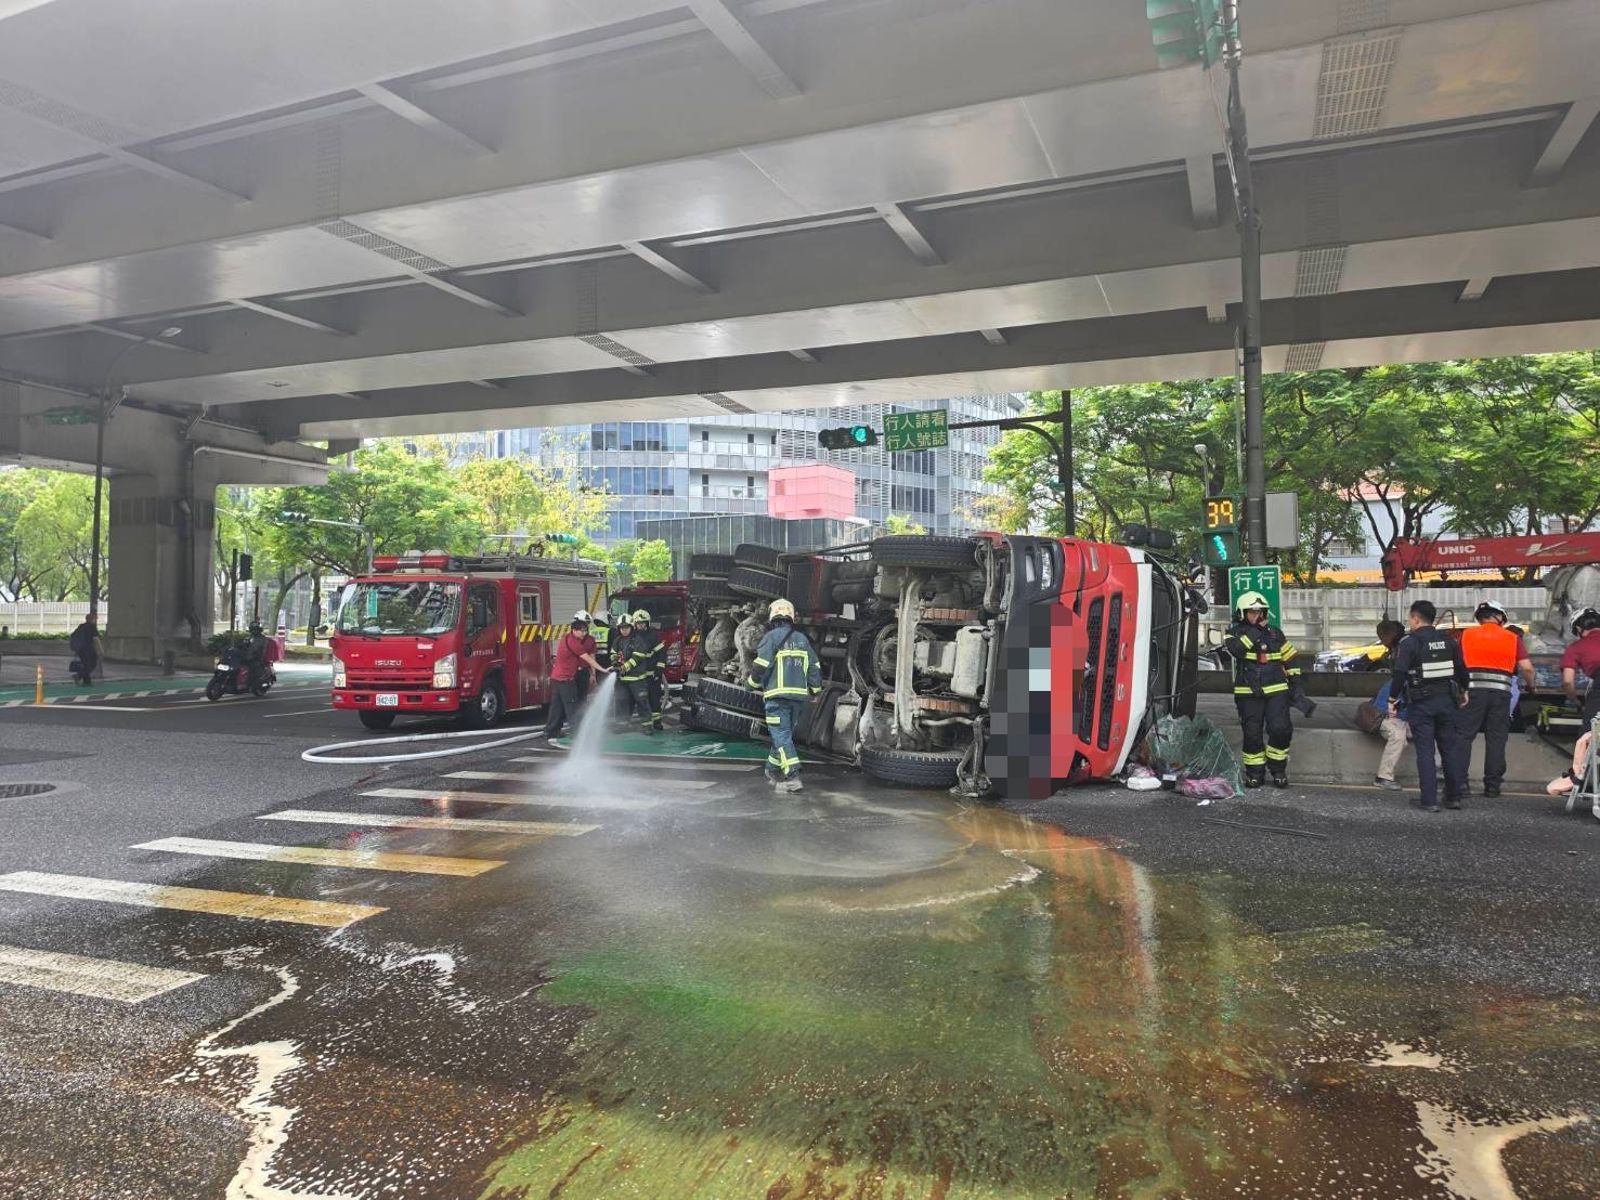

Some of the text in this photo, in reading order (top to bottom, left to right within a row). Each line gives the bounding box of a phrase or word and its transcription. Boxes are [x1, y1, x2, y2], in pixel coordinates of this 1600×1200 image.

[885, 411, 946, 431] 行人請看
[886, 431, 947, 449] 行人號誌
[1208, 500, 1234, 528] 39
[1438, 544, 1477, 556] UNIC
